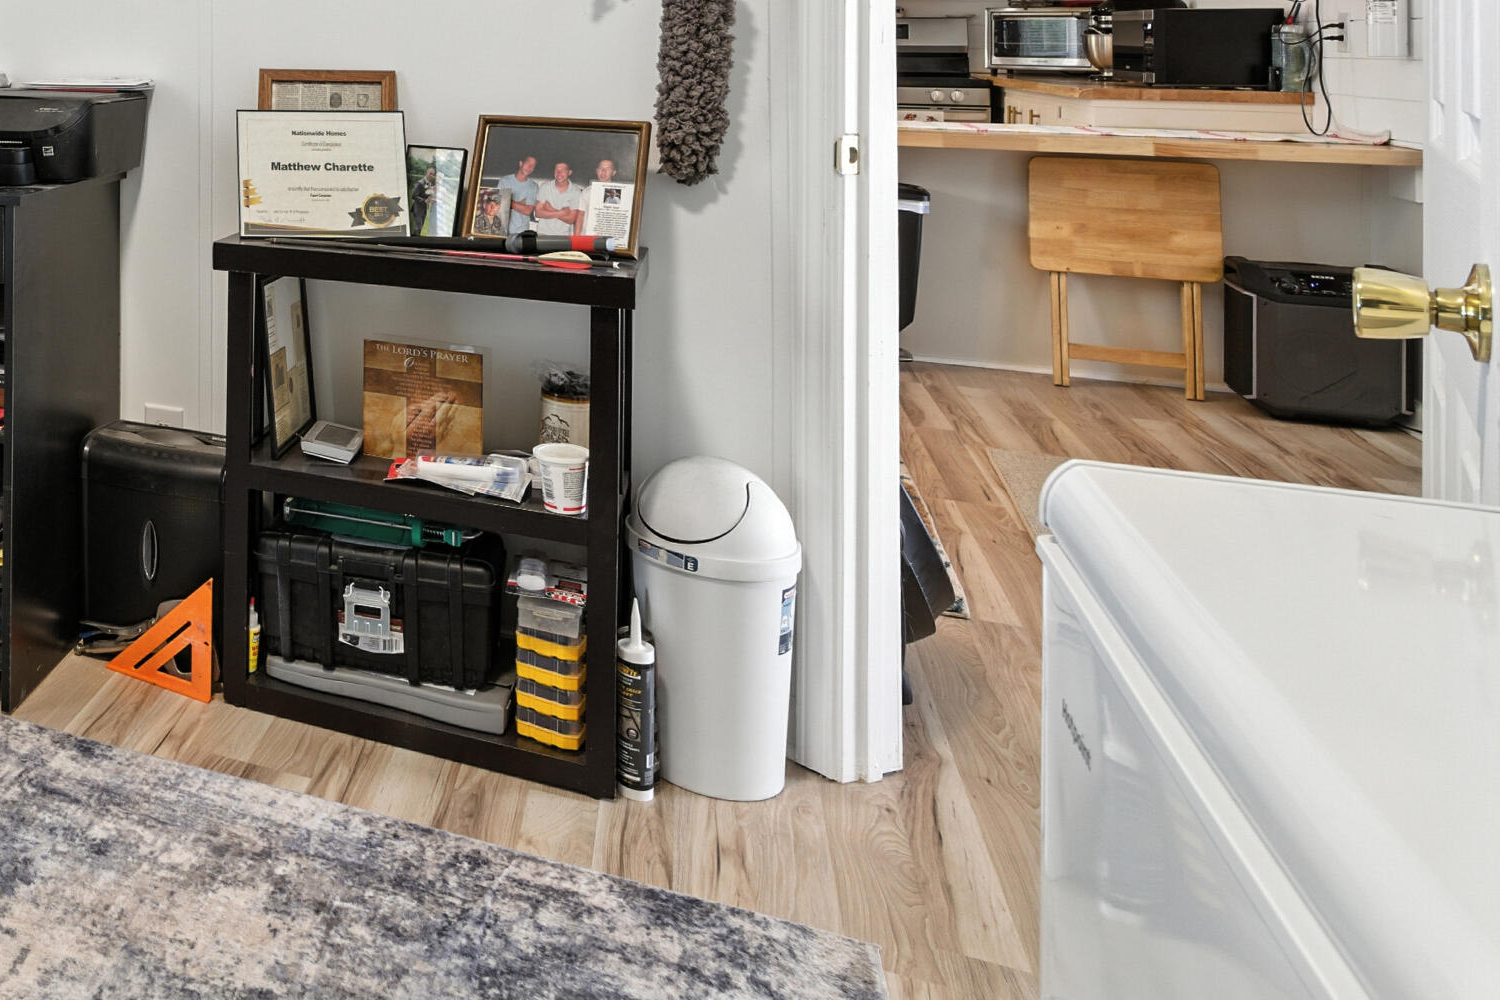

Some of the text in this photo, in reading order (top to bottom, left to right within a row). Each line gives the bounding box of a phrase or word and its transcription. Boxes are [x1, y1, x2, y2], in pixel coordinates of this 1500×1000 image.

[271, 162, 374, 172] Matthew Charette
[430, 350, 468, 363] PRAYER
